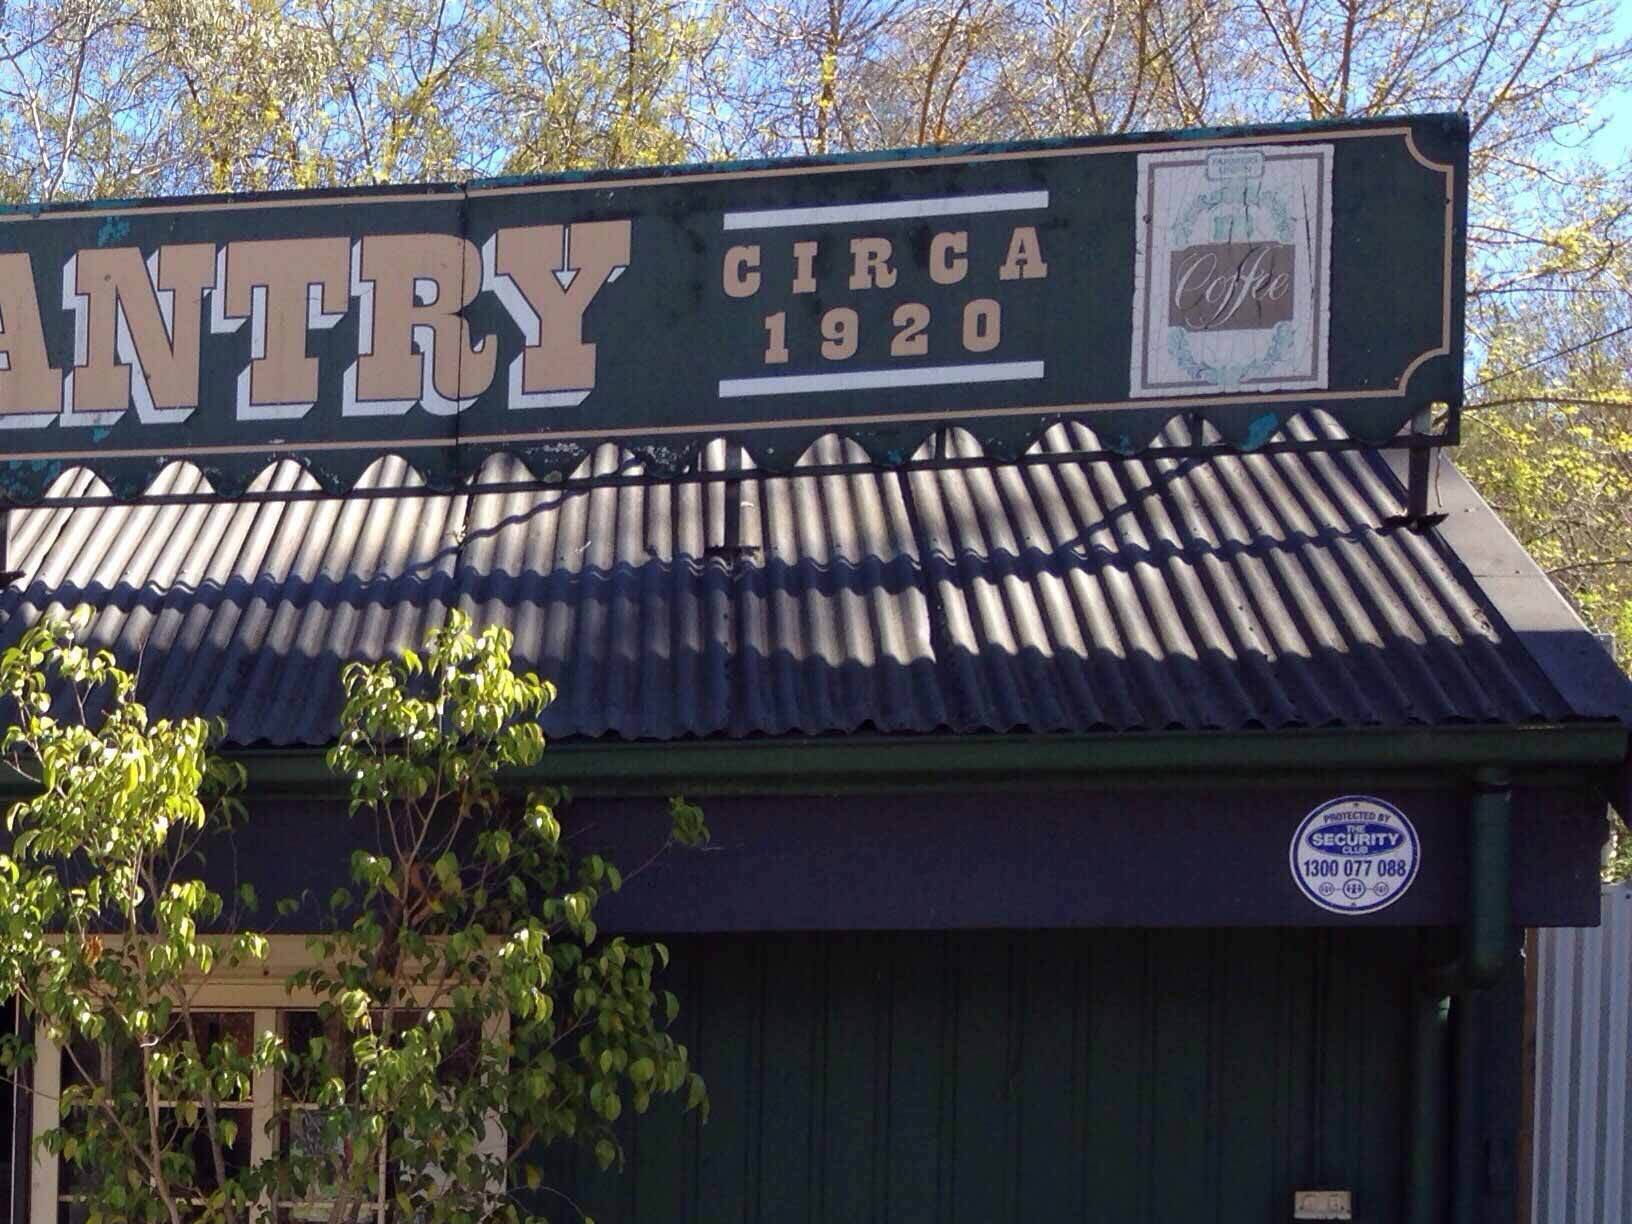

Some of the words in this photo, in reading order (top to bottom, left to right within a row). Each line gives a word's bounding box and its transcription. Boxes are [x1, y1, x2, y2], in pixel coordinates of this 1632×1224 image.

[722, 226, 1048, 299] CIRCA
[1174, 246, 1290, 329] Coffee
[764, 298, 1001, 364] 1920
[1323, 811, 1376, 823] PROTECTED
[1377, 813, 1392, 822] BY
[1346, 825, 1366, 833] THE
[1312, 833, 1399, 846] SECURITY
[1342, 846, 1368, 854] CLUB
[1304, 860, 1338, 877] 1300
[1344, 860, 1372, 877] 077
[1378, 860, 1407, 877] 088
